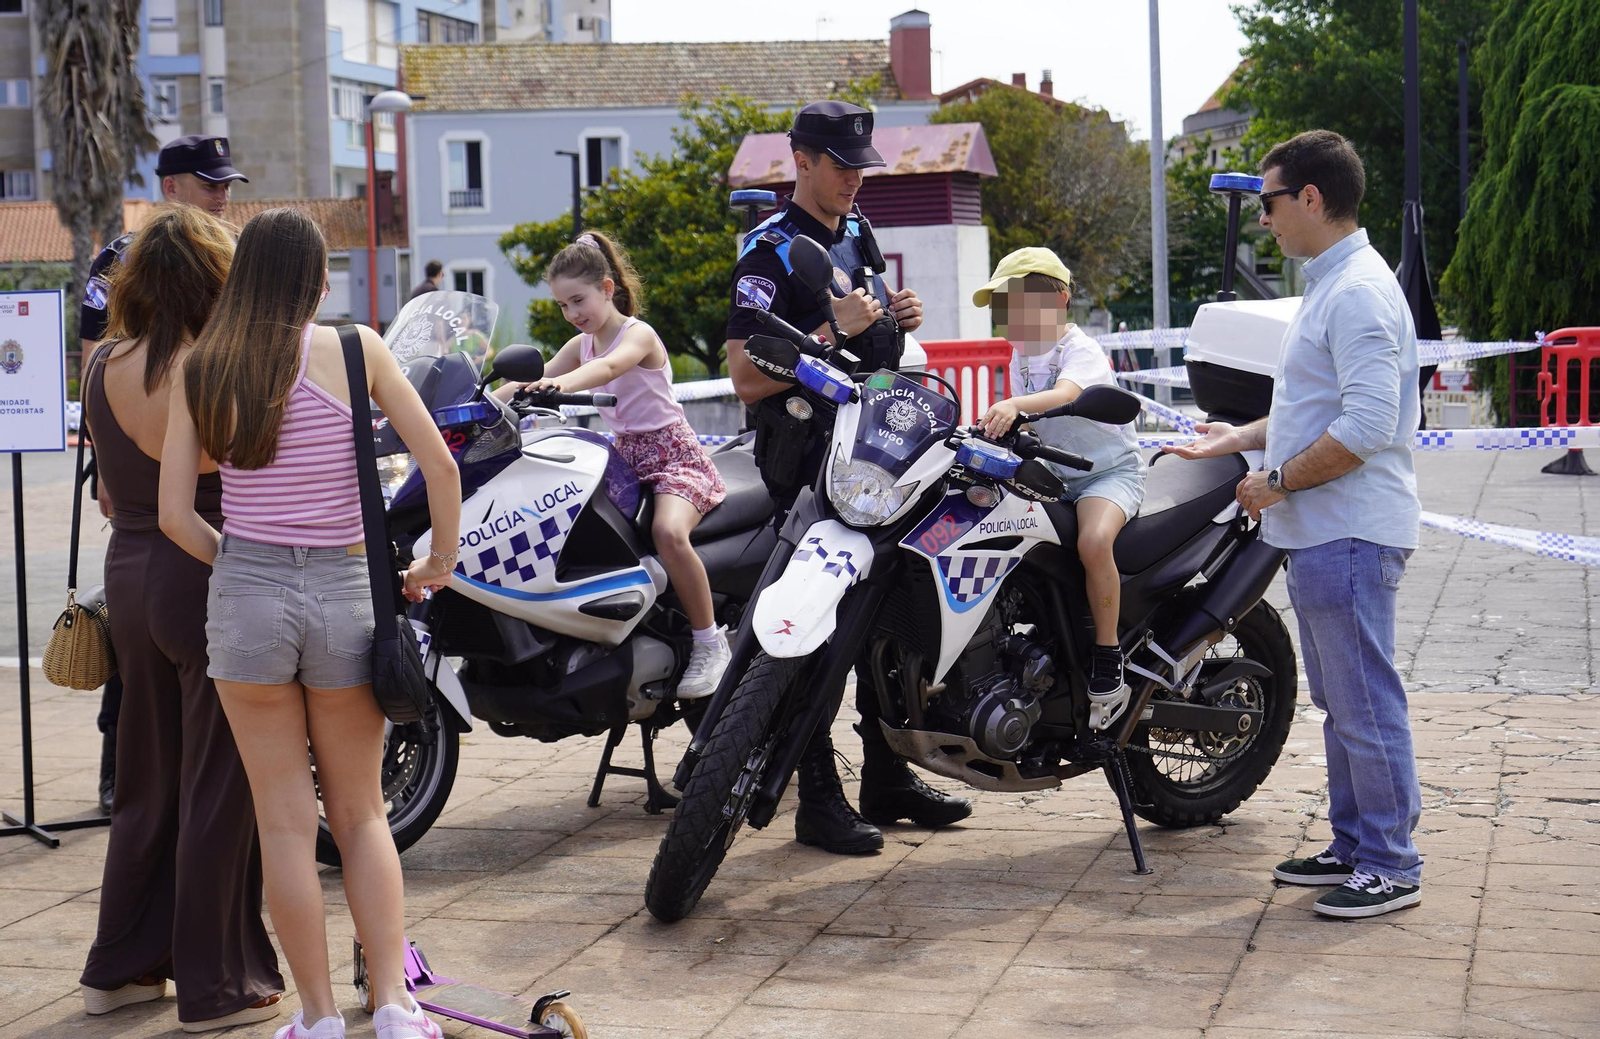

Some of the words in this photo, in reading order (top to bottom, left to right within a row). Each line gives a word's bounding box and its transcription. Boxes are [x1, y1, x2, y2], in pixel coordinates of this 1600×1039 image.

[435, 305, 469, 346] LOCAL
[868, 388, 915, 406] POLICÍA
[916, 397, 937, 434] LOCAL
[878, 428, 904, 446] VIGO
[534, 480, 583, 513] LOCAL
[920, 514, 962, 554] 092
[979, 517, 1012, 534] POLICÍA
[1016, 516, 1039, 530] LOCAL
